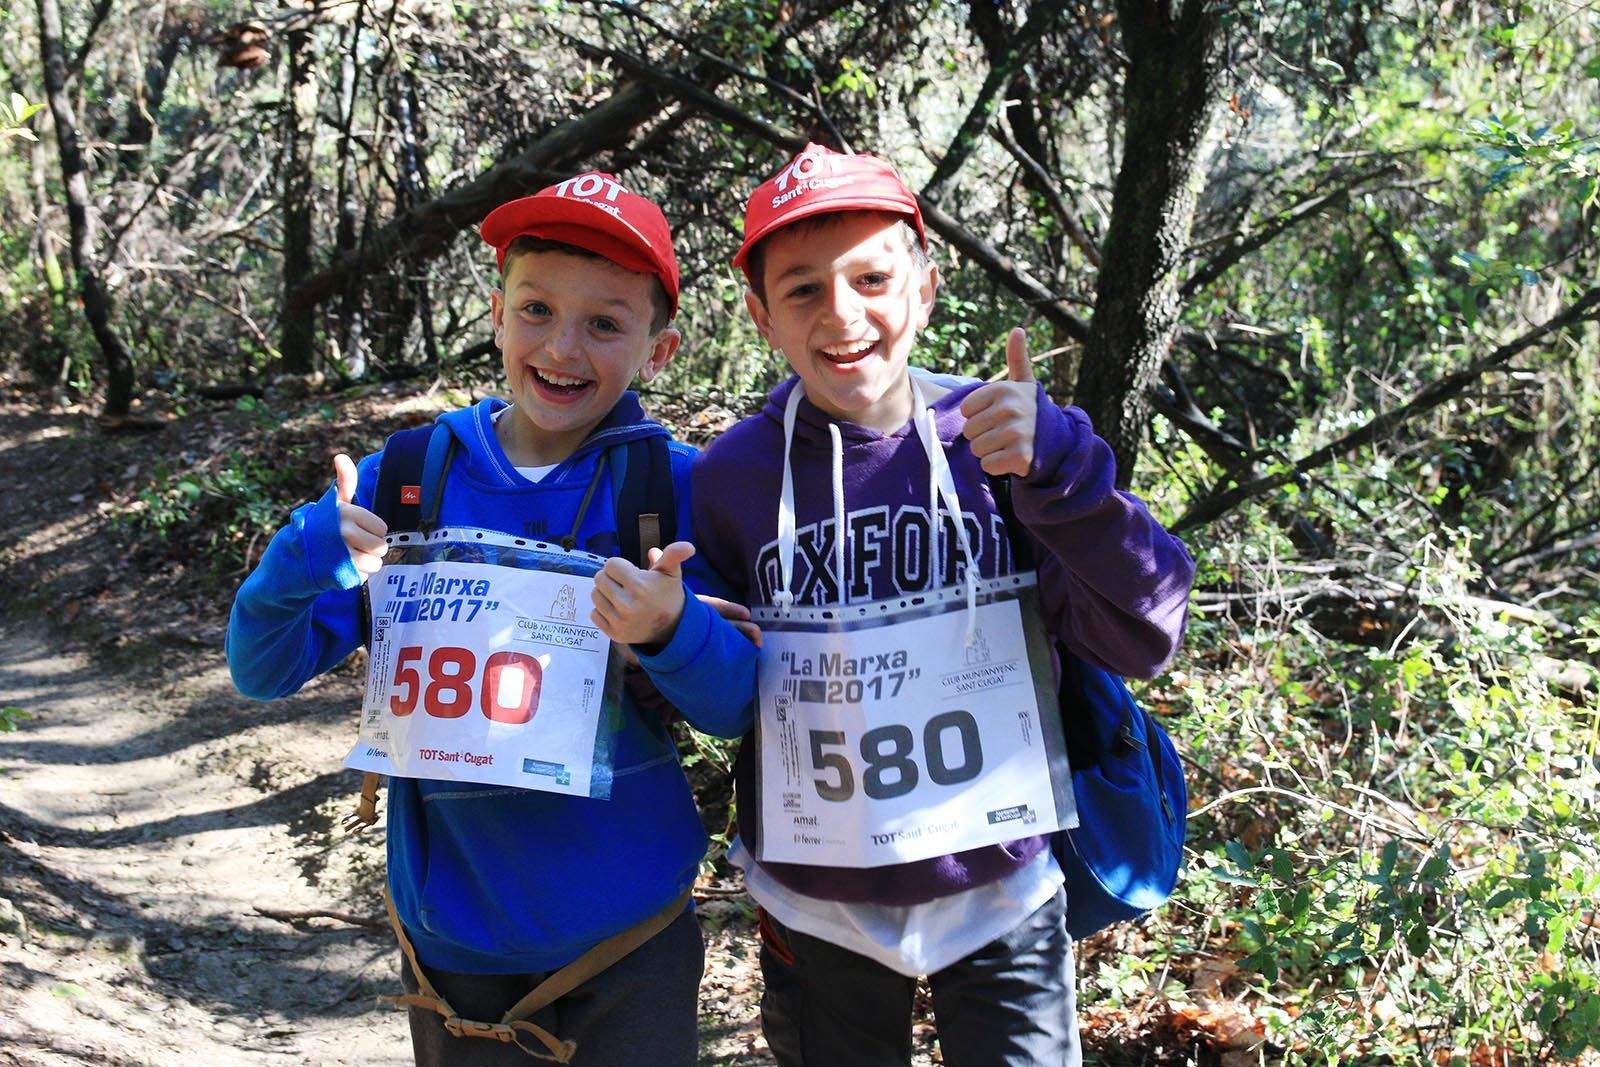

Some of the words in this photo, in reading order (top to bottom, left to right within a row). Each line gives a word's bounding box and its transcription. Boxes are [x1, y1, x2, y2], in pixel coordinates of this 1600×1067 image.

[774, 151, 850, 192] TOT
[555, 174, 629, 202] TOT
[772, 183, 803, 208] Sant
[420, 572, 491, 596] Marxa
[517, 620, 538, 630] CLUB
[819, 650, 908, 677] Marxa
[390, 646, 543, 725] 580
[420, 749, 438, 760] TOT
[439, 752, 460, 762] Sant
[464, 752, 494, 766] Cugat
[808, 710, 983, 802] 580
[871, 832, 897, 846] TOT
